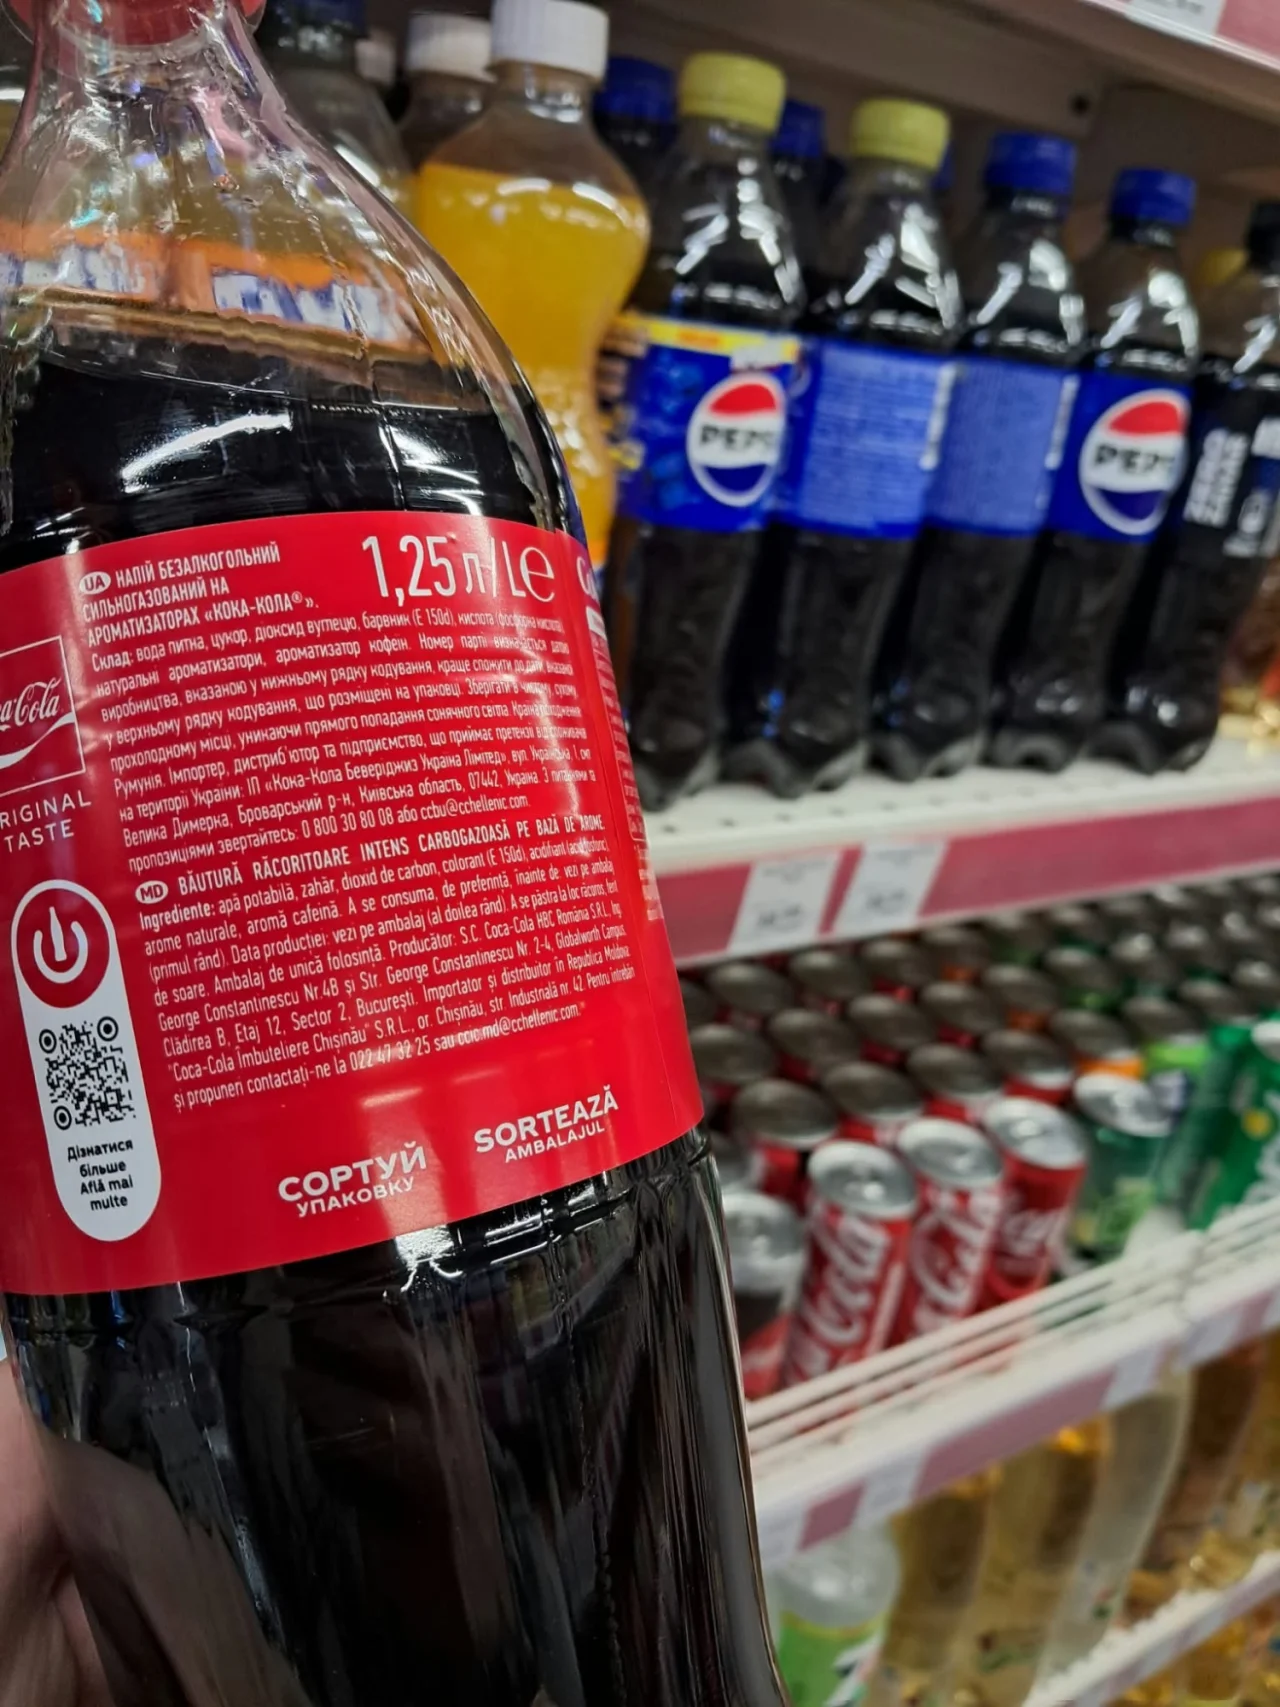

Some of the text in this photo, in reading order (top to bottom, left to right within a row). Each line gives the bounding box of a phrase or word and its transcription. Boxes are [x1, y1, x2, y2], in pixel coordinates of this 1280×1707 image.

[83, 541, 281, 592] UA НАПІЙ БЕЗАЛКОГОЛЬНИЙ
[362, 535, 456, 607] 1,25
[83, 576, 230, 623] СИЛЬНОГАЗОВАНИЙ НА
[88, 605, 201, 648] АРОМАТИЗАТОРАХ
[91, 651, 134, 672] Склад:
[136, 643, 166, 662] вода
[168, 635, 209, 654] питна,
[210, 628, 252, 651] цукор,
[255, 621, 306, 644] діоксид
[306, 616, 361, 638] вуглецю,
[361, 610, 412, 632] барвник
[425, 607, 457, 626] 150d),
[457, 612, 494, 626] кислота
[96, 631, 488, 697] натуральні ароматизатори, ароматизатор Номер партії
[101, 692, 183, 723] виробництва,
[185, 680, 248, 704] вказаною
[260, 670, 327, 690] нижньому
[330, 665, 368, 686] рядку
[370, 660, 436, 680] кодування,
[437, 659, 471, 677] краще
[472, 659, 512, 672] спожити
[116, 718, 180, 746] верхньому
[184, 710, 223, 734] рядку
[227, 698, 302, 722] кодування,
[304, 694, 325, 711] що
[328, 683, 393, 711] розміщені
[395, 686, 411, 700] на
[412, 678, 464, 703] упаковці.
[464, 676, 511, 698] Зберігати
[110, 705, 481, 775] прохолодному місці, уникаючи прямого попадання сонячного
[114, 725, 494, 800] Румунія. Імпортер, та підприємство, що приймає
[0, 790, 91, 829] RIGINAL
[119, 753, 462, 822] на території України: ІП «Кока-Кола Беверіджиз Україна
[123, 783, 414, 848] Велика Димерка, Броварський р-н, Київська
[4, 818, 74, 853] TASTE
[128, 804, 418, 876] пропозиціями звертайтесь: 800 30 80 08 або
[139, 818, 511, 902] MD BĂUTURĂ RĂCORITOARE INTENS CARBOGAZOASĂ
[139, 901, 216, 933] Ingrediente:
[218, 892, 241, 918] apă
[243, 882, 299, 914] potabilă,
[300, 876, 339, 898] zahăr,
[341, 866, 378, 891] dioxid
[380, 864, 395, 884] de
[397, 859, 441, 881] carbon,
[441, 852, 486, 874] colorant
[144, 879, 456, 956] arome naturale, aromă cafeină. se consuma, de
[149, 954, 192, 985] (primul
[193, 948, 228, 972] rând).
[230, 944, 261, 964] Data
[332, 927, 357, 944] vezi
[359, 923, 375, 944] pe
[377, 909, 426, 935] ambalaj
[426, 905, 443, 927] (al
[444, 901, 478, 923] doilea
[518, 895, 530, 909] se
[154, 986, 169, 1007] de
[172, 983, 210, 1003] soare.
[214, 966, 265, 994] Ambalaj
[268, 962, 285, 983] de
[288, 955, 324, 979] unică
[388, 932, 457, 959] Producător:
[158, 946, 514, 1032] George Constantinescu Nr.4B și Str. George Constantinescu
[163, 1033, 212, 1057] Clădirea
[234, 1020, 261, 1050] Etaj
[265, 1015, 286, 1036] 12,
[290, 1009, 332, 1031] Sector
[422, 977, 482, 1004] Importator
[173, 1034, 455, 1114] și propuneri contactați-ne la 022 47 32 25 sau
[236, 1015, 415, 1069] Îmbuteliere S.R.L.,
[67, 1139, 133, 1163] Дізнатися
[474, 1084, 619, 1154] SORTEAZĂ
[505, 1120, 606, 1164] AMBALAJUL
[79, 1160, 126, 1178] більше
[80, 1175, 133, 1196] Află mai
[278, 1140, 427, 1203] СОРТУЙ
[297, 1176, 415, 1218] УПАКОВКУ
[90, 1195, 128, 1212] multe
